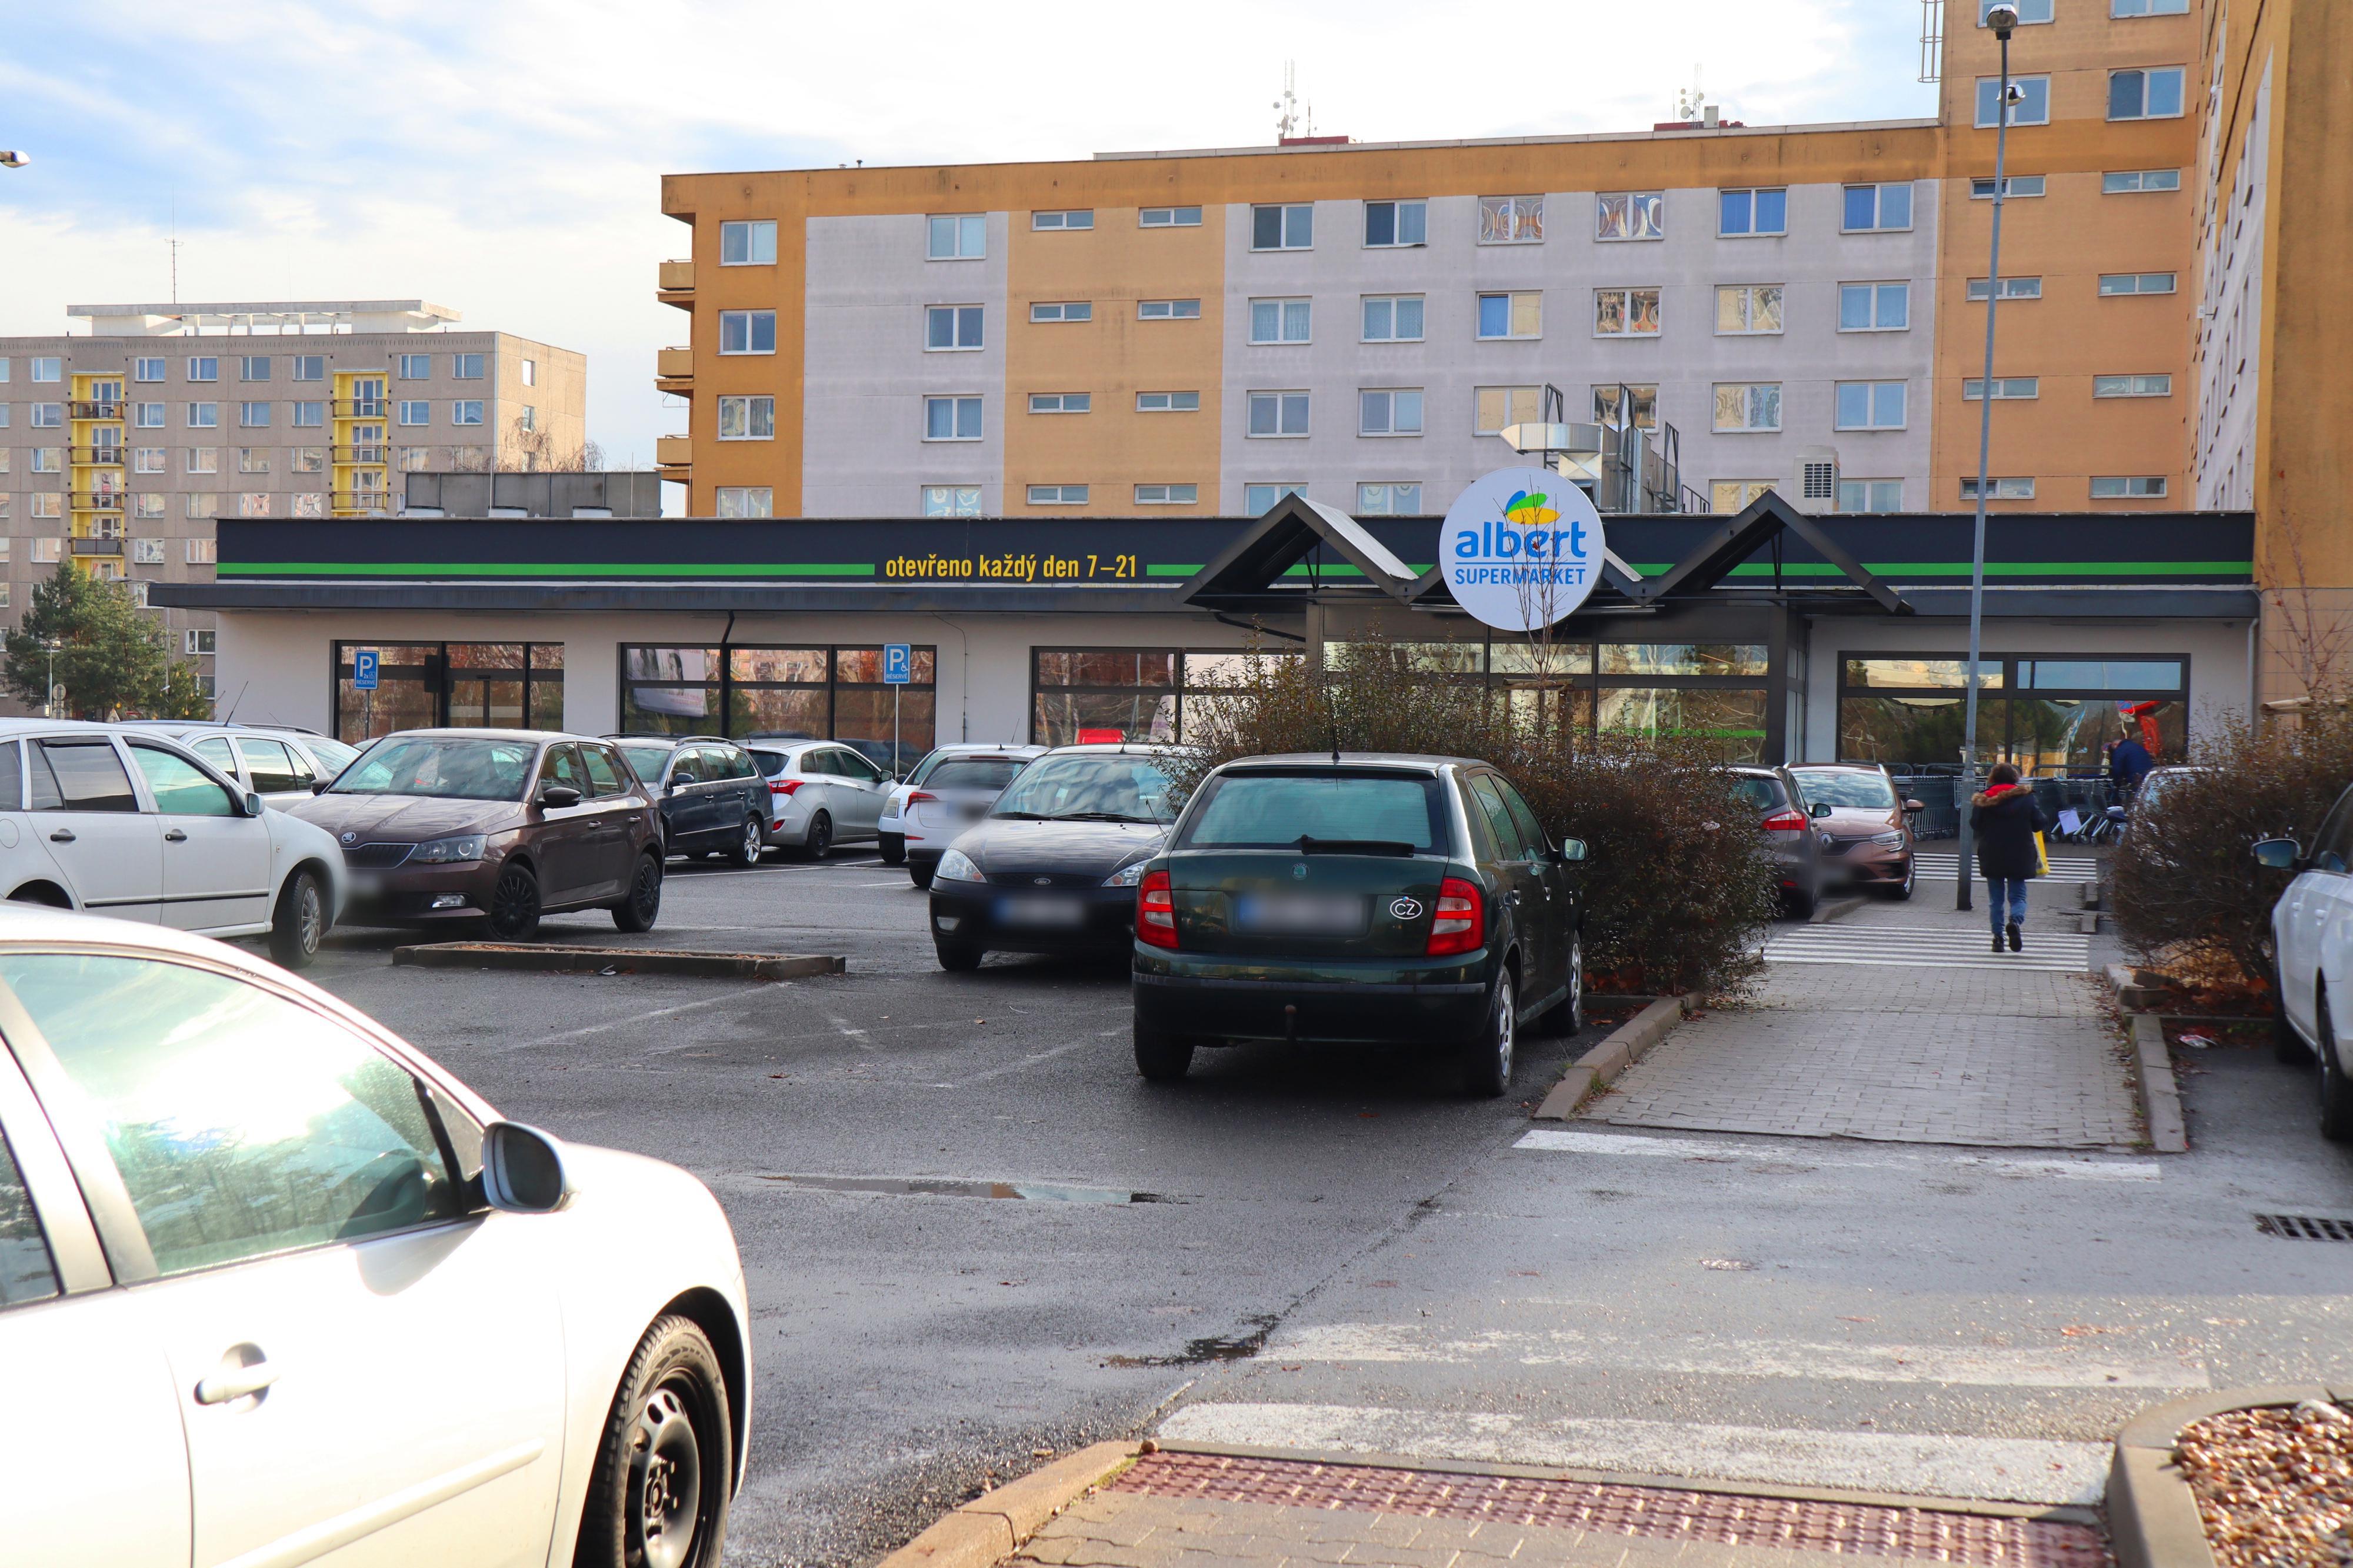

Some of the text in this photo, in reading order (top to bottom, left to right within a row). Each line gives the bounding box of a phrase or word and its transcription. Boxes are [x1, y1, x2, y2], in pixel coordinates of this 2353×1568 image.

[1455, 521, 1587, 558] albert
[885, 554, 972, 577] otevřeno
[979, 554, 1036, 582] každý
[1043, 555, 1079, 577] den
[1455, 568, 1586, 584] SUPERMARKET
[360, 656, 373, 677] P
[890, 649, 904, 671] P
[1395, 903, 1415, 915] CZ
